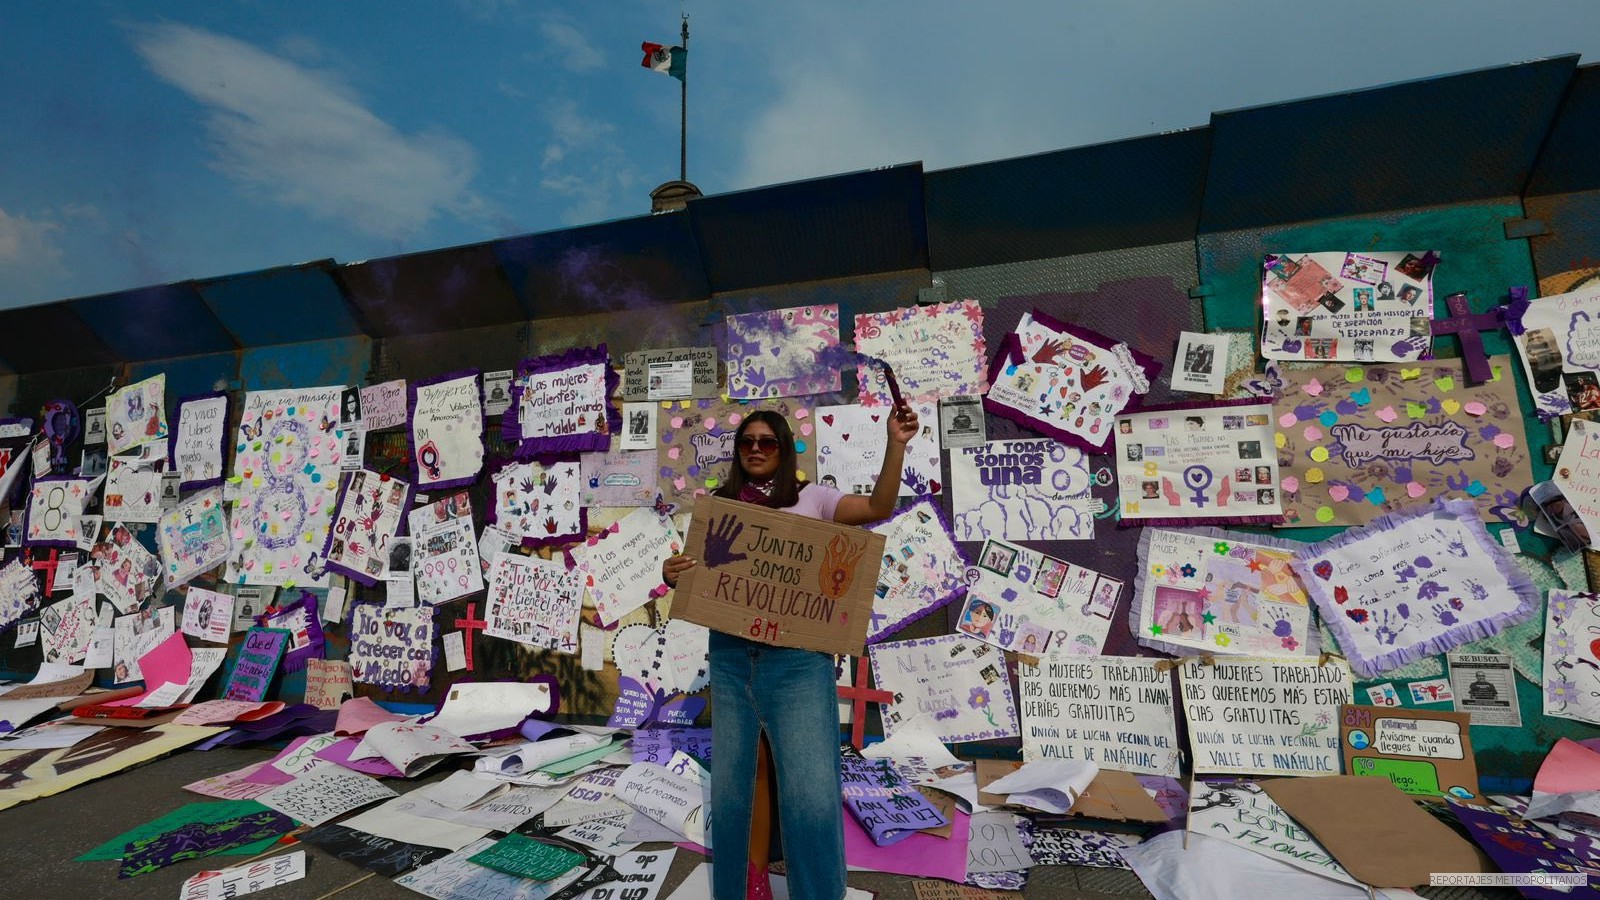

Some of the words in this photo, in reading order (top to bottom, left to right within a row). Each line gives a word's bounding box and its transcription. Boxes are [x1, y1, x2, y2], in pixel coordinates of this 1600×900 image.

[1347, 328, 1405, 337] ESPERANZA
[625, 354, 637, 365] En
[639, 353, 666, 366] Jerez
[666, 349, 713, 362] Zacatecas
[626, 368, 643, 376] desde
[626, 377, 642, 385] Hace
[530, 377, 547, 391] Las
[552, 372, 589, 391] mujeres
[278, 398, 295, 407] un
[298, 391, 338, 409] mensaje
[423, 382, 474, 407] Mujeres
[530, 390, 576, 407] valientes
[449, 403, 480, 413] Valientes
[575, 400, 604, 414] mundo
[368, 413, 398, 430] miedo
[416, 428, 430, 441] 8M
[698, 433, 714, 447] Me
[1340, 426, 1371, 442] Me
[1381, 424, 1464, 448] gustaría
[1003, 440, 1056, 454] TODAS
[974, 452, 1045, 467] somos
[1345, 448, 1373, 468] que
[1382, 445, 1412, 457] mi
[980, 465, 1042, 486] una
[1052, 492, 1063, 501] de
[747, 524, 814, 563] JUNTAS
[1153, 543, 1178, 555] MUJER
[1184, 535, 1196, 546] LA
[597, 556, 635, 584] valientes
[637, 534, 671, 558] cambian
[510, 563, 526, 587] Tu
[750, 558, 802, 585] SOMOS
[1363, 569, 1385, 583] como
[615, 579, 627, 591] el
[714, 571, 836, 624] REVOLUCIÓN
[360, 613, 379, 635] No
[386, 620, 411, 642] voy
[414, 624, 428, 640] a
[407, 647, 431, 661] con
[924, 653, 937, 673] te
[1472, 655, 1501, 663] BUSCA
[364, 660, 412, 684] Miedo
[1022, 663, 1041, 678] LAS
[1049, 663, 1094, 680] MUJERES
[1183, 663, 1206, 680] LAS
[1213, 665, 1264, 683] MUJERES
[1024, 681, 1043, 697] RAS
[1049, 683, 1101, 700] QUEREMOS
[1110, 684, 1132, 702] MÁS
[1139, 687, 1172, 706] LAVAN-
[1185, 684, 1206, 701] RAS
[1212, 685, 1277, 704] QUEREMOS
[1283, 685, 1308, 705] MÁS
[1314, 688, 1351, 705] ESTAN-
[1024, 699, 1060, 718] DERÍAS
[1068, 703, 1136, 723] GRATUITAS
[1188, 704, 1214, 722] CIAS
[1223, 706, 1301, 726] GRATUITAS
[1343, 708, 1372, 729] 8M
[1031, 725, 1060, 739] UNIÓN
[1066, 729, 1078, 739] DE
[1083, 729, 1111, 742] LUCHA
[1117, 732, 1152, 747] VECINAL
[1154, 735, 1171, 749] DEL
[1196, 729, 1226, 745] UNIÓN
[1232, 733, 1244, 745] DE
[1248, 733, 1275, 746] LUCHA
[1280, 735, 1321, 748] VECINAL
[1379, 730, 1416, 744] Avísame
[1422, 735, 1455, 745] cuando
[1040, 744, 1075, 759] VALLE
[1084, 747, 1095, 762] DE
[1103, 747, 1158, 769] ANÁHUAC
[1380, 741, 1412, 753] llegues
[1418, 743, 1438, 756] hija
[1209, 750, 1246, 768] VALLE
[1252, 752, 1266, 768] DE
[1272, 751, 1334, 771] ANÁHUAC
[855, 798, 888, 815] hay
[968, 847, 1023, 867] HOY
